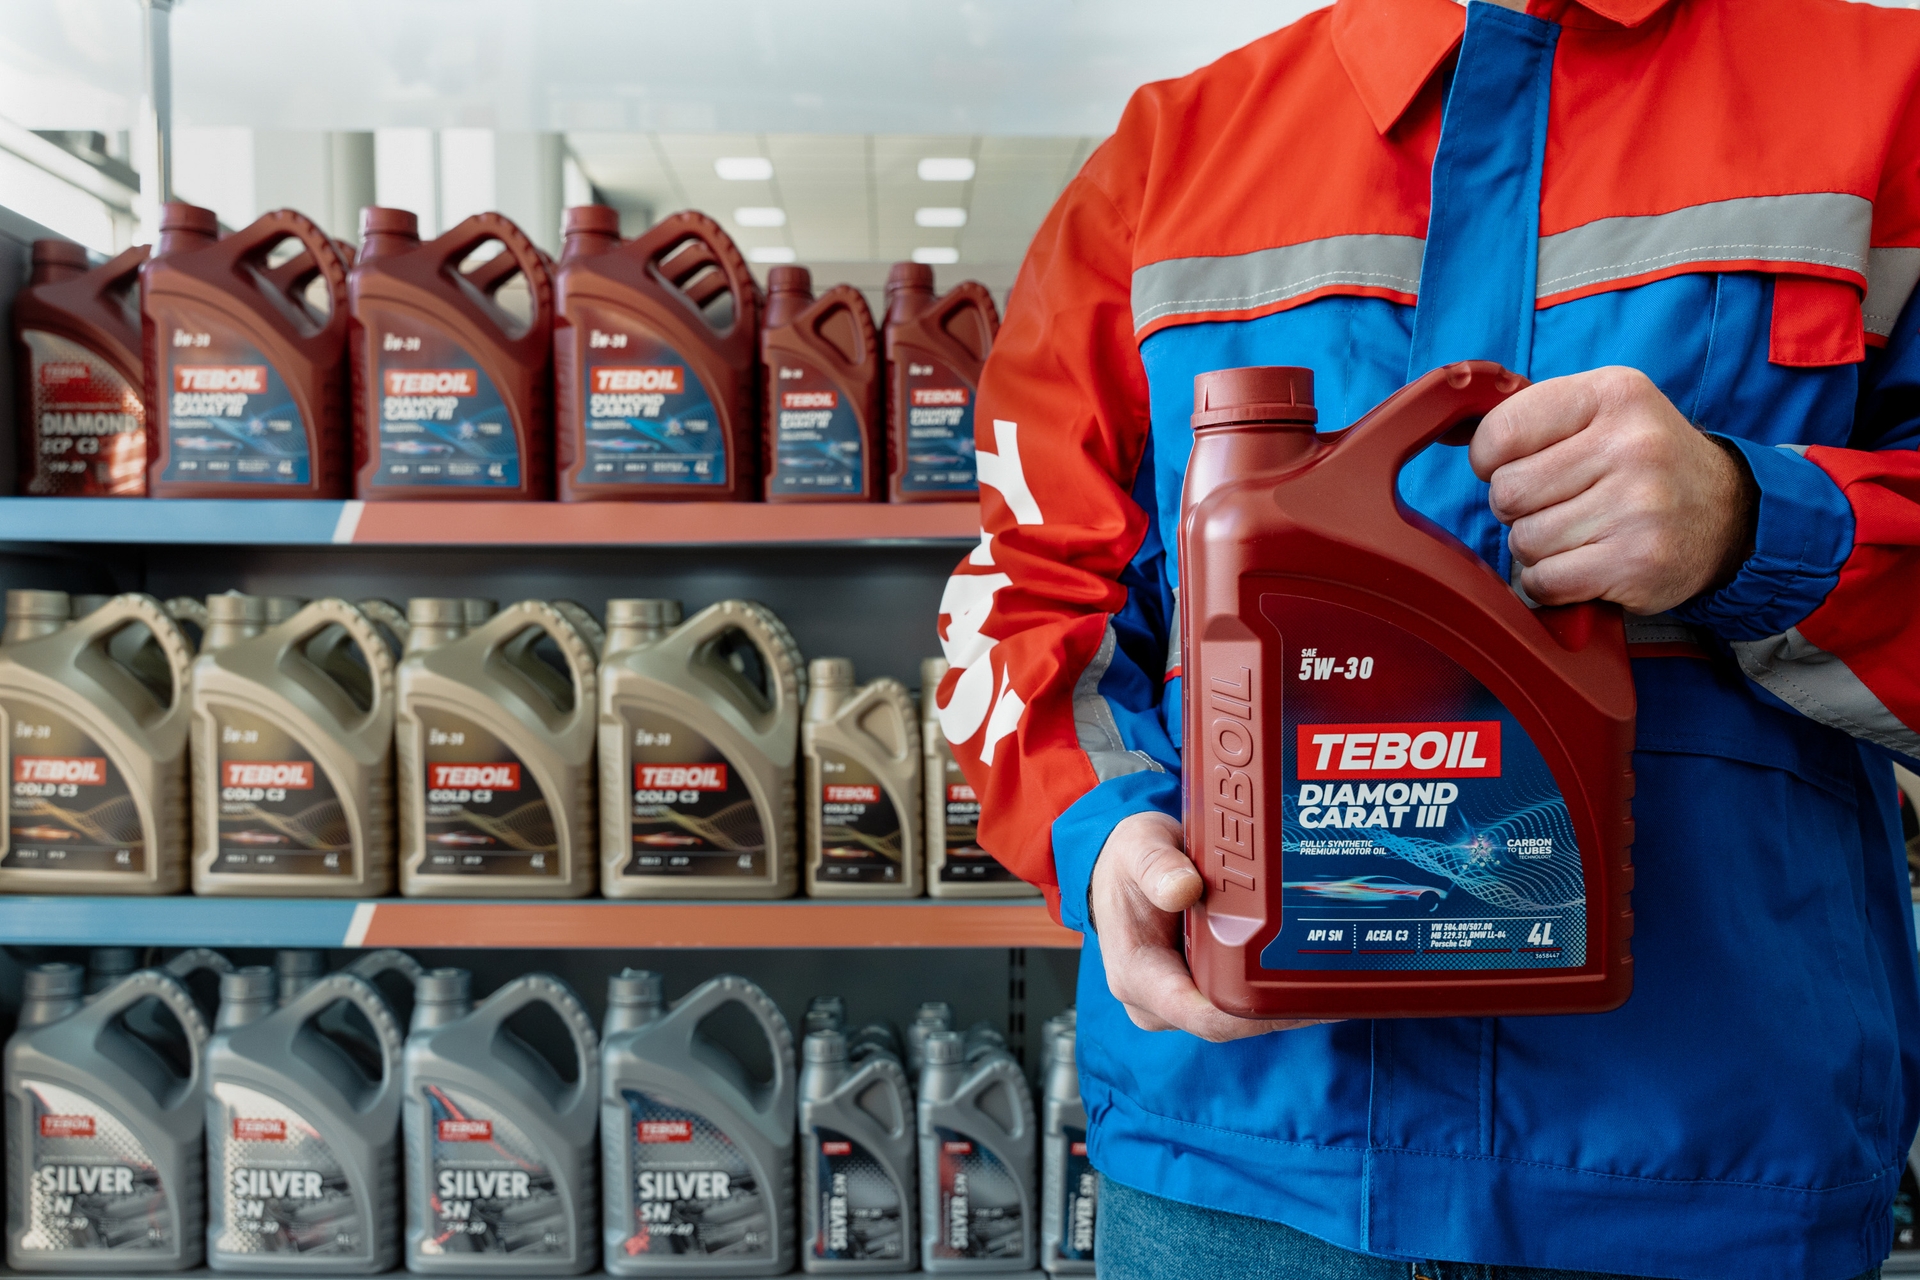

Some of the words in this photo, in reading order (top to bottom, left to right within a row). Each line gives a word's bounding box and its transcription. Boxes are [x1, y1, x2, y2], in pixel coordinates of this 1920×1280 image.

[180, 369, 261, 390] TEBOIL
[391, 372, 471, 393] TEBOIL
[596, 370, 678, 390] TEBOIL
[784, 392, 835, 408] TEBOIL
[914, 389, 965, 404] TEBOIL
[42, 413, 138, 436] DIAMOND
[1301, 648, 1318, 658] SAE
[1298, 656, 1374, 680] 5W-30
[1312, 731, 1487, 771] TEBOIL
[22, 760, 100, 781] TEBOIL
[228, 764, 307, 785] TEBOIL
[435, 766, 514, 787] TEBOIL
[642, 767, 720, 788] TEBOIL
[1211, 666, 1256, 892] TEBOIL
[14, 782, 56, 796] GOLD
[222, 787, 264, 801] GOLD
[266, 788, 286, 802] C3
[428, 789, 471, 803] GOLD
[472, 790, 493, 803] C3
[635, 790, 678, 804] GOLD
[679, 790, 700, 804] C3
[827, 786, 876, 800] TEBOIL
[1298, 782, 1458, 806] DIAMOND
[1298, 806, 1410, 829] CARAT
[1416, 806, 1448, 828] III
[1300, 848, 1340, 856] PREMIUM
[1341, 848, 1372, 856] MOTOR
[1372, 847, 1387, 855] OIL
[1506, 838, 1552, 846] CARBON
[1518, 846, 1552, 854] LUBES
[1308, 930, 1326, 941] API
[1328, 930, 1344, 941] SN
[1366, 930, 1393, 942] ACEA
[1394, 930, 1408, 941] C3
[1527, 922, 1554, 945] 4L
[40, 1166, 134, 1194] SILVER
[234, 1169, 324, 1198] SILVER
[439, 1170, 530, 1198] SILVER
[639, 1172, 730, 1200] SILVER
[43, 1196, 74, 1216] SN
[236, 1200, 264, 1219] SN
[441, 1200, 472, 1220] SN
[641, 1202, 672, 1222] SN
[830, 1197, 848, 1250] SILVER
[951, 1196, 969, 1249] SILVER
[1074, 1197, 1093, 1250] SILVER
